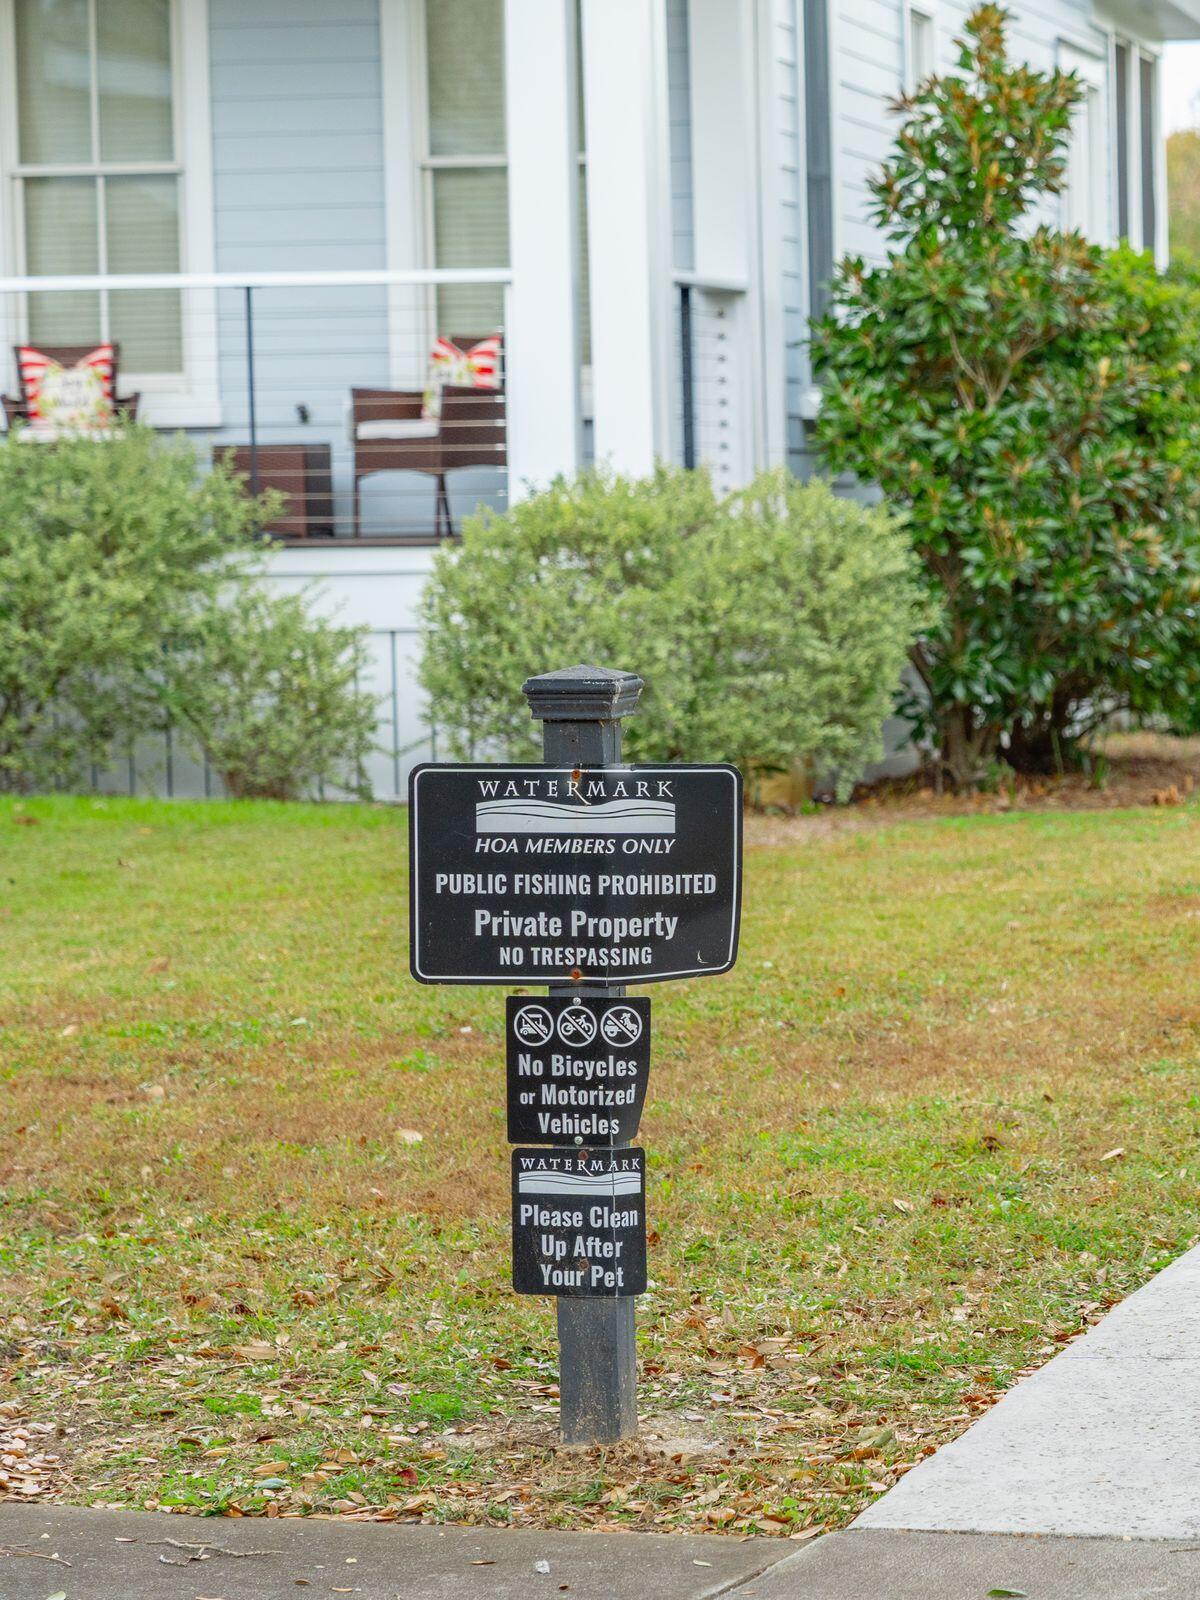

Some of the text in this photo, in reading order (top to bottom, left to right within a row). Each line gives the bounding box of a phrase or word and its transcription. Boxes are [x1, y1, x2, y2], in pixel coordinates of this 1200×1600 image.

[478, 780, 674, 806] WATERMARK
[475, 838, 676, 855] HOA MEMBERS ONLY
[435, 873, 717, 896] PUBLIC FISHING PROHIBITED
[474, 909, 679, 943] Private Property
[499, 946, 652, 966] NO TRESPASSING
[518, 1053, 638, 1081] No Bicycles
[519, 1083, 637, 1106] or Motorized
[538, 1112, 620, 1135] Vehicles
[520, 1157, 641, 1177] WATERMARK
[520, 1204, 639, 1228] Please Clean
[541, 1234, 624, 1261] Up After
[540, 1264, 625, 1287] Your Pet
